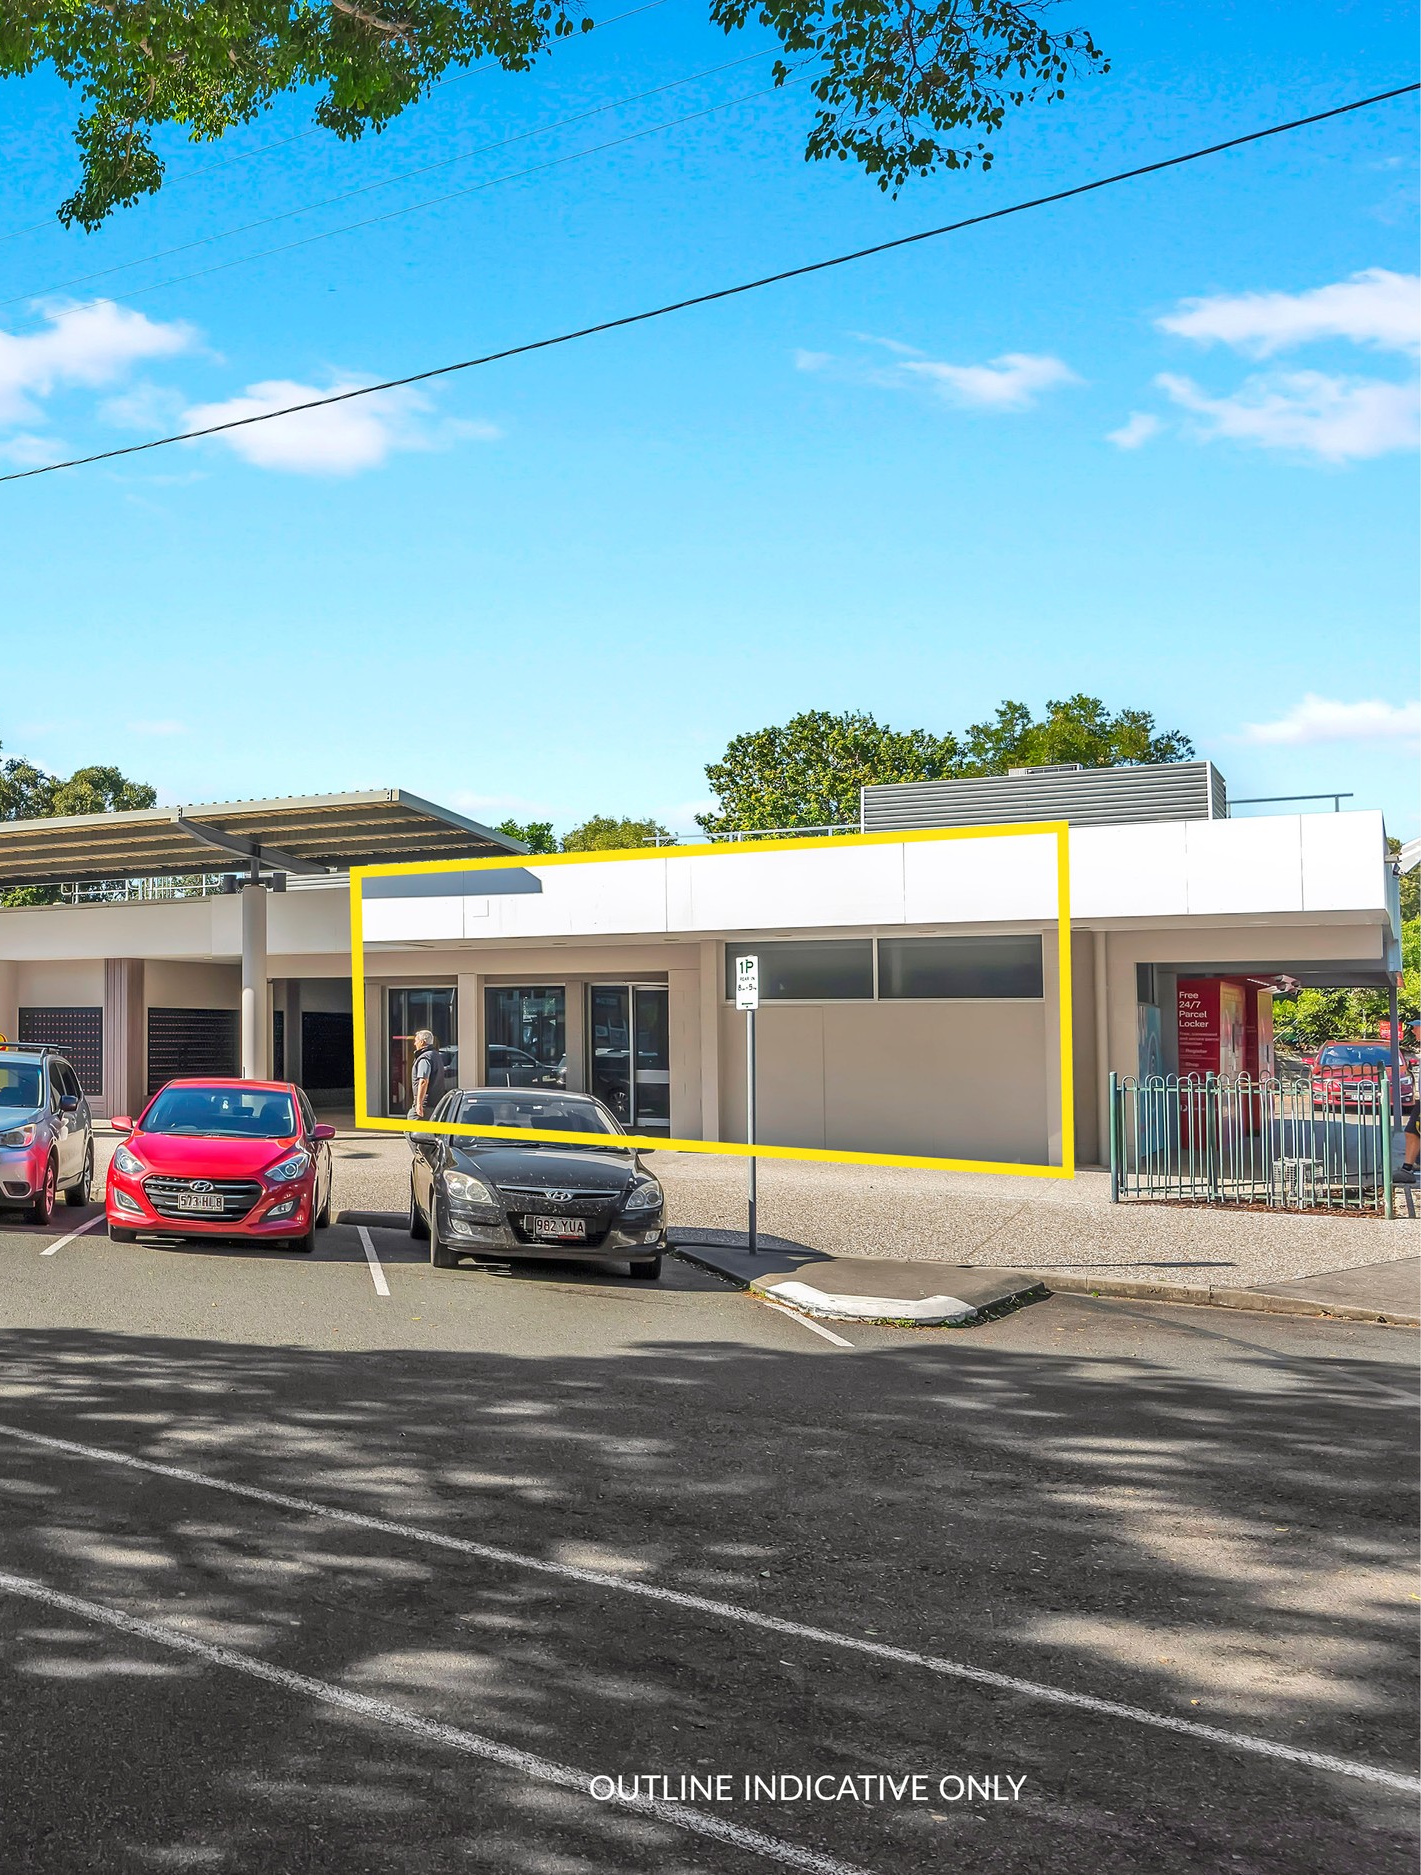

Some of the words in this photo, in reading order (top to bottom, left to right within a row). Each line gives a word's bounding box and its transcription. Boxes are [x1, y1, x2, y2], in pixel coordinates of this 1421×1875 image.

[740, 961, 754, 973] 1P
[1179, 1001, 1201, 1009] 24/7
[537, 1220, 556, 1231] 982
[562, 1221, 584, 1232] YUA
